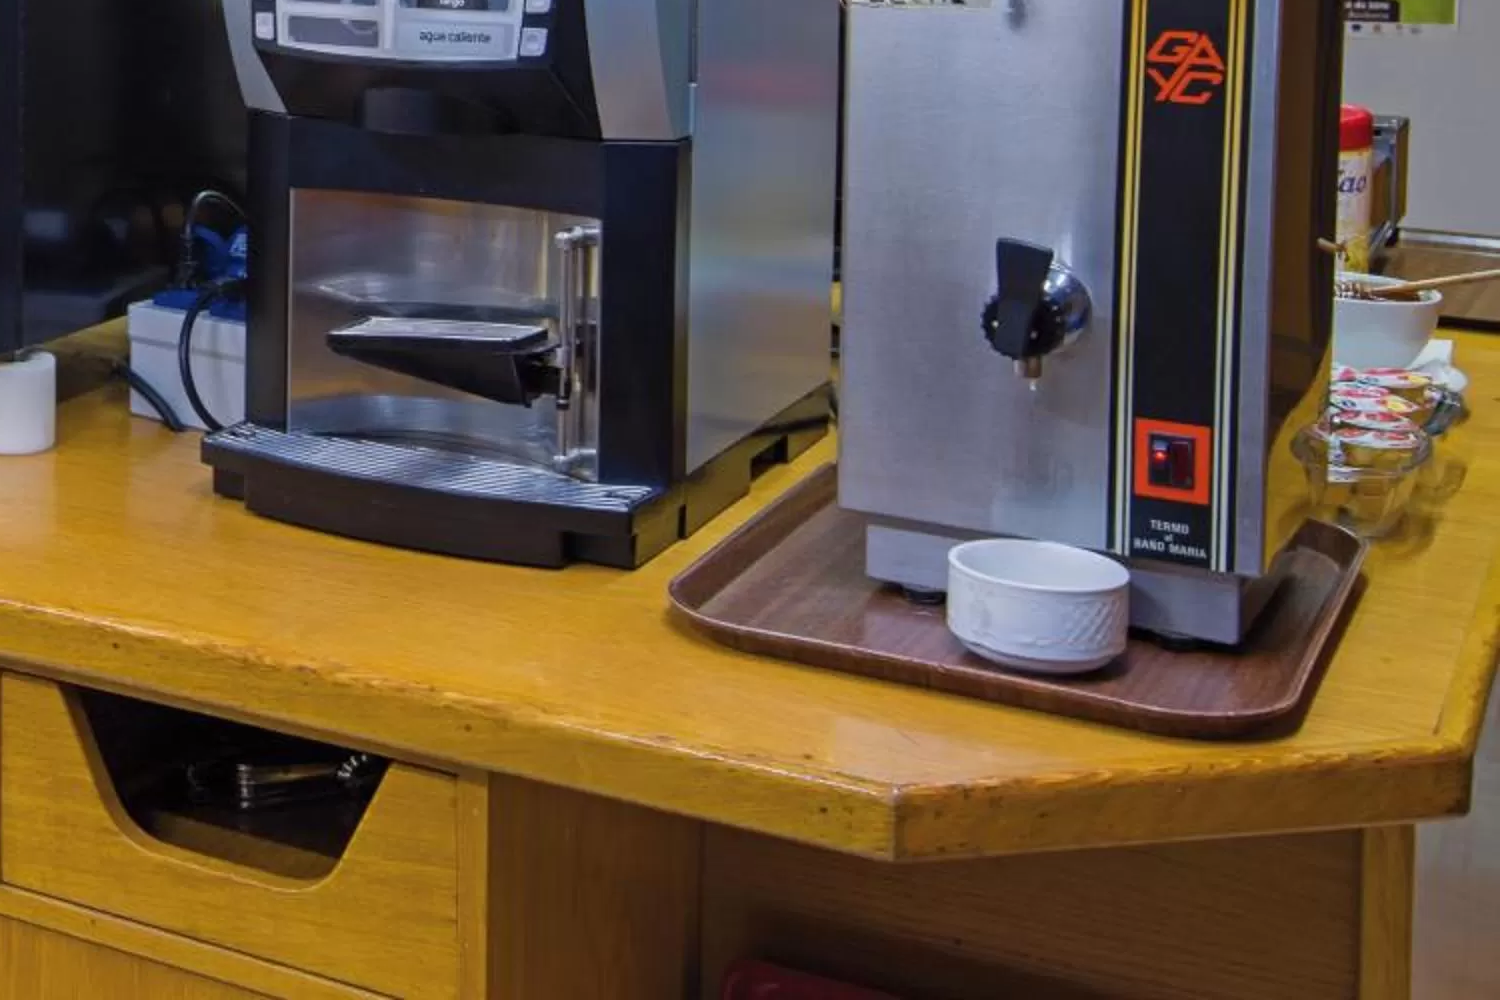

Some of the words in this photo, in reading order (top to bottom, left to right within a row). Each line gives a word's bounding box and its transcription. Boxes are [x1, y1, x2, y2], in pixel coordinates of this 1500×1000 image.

[1338, 170, 1367, 194] ao
[1150, 519, 1190, 535] TERMO
[1133, 536, 1165, 552] BAÑO
